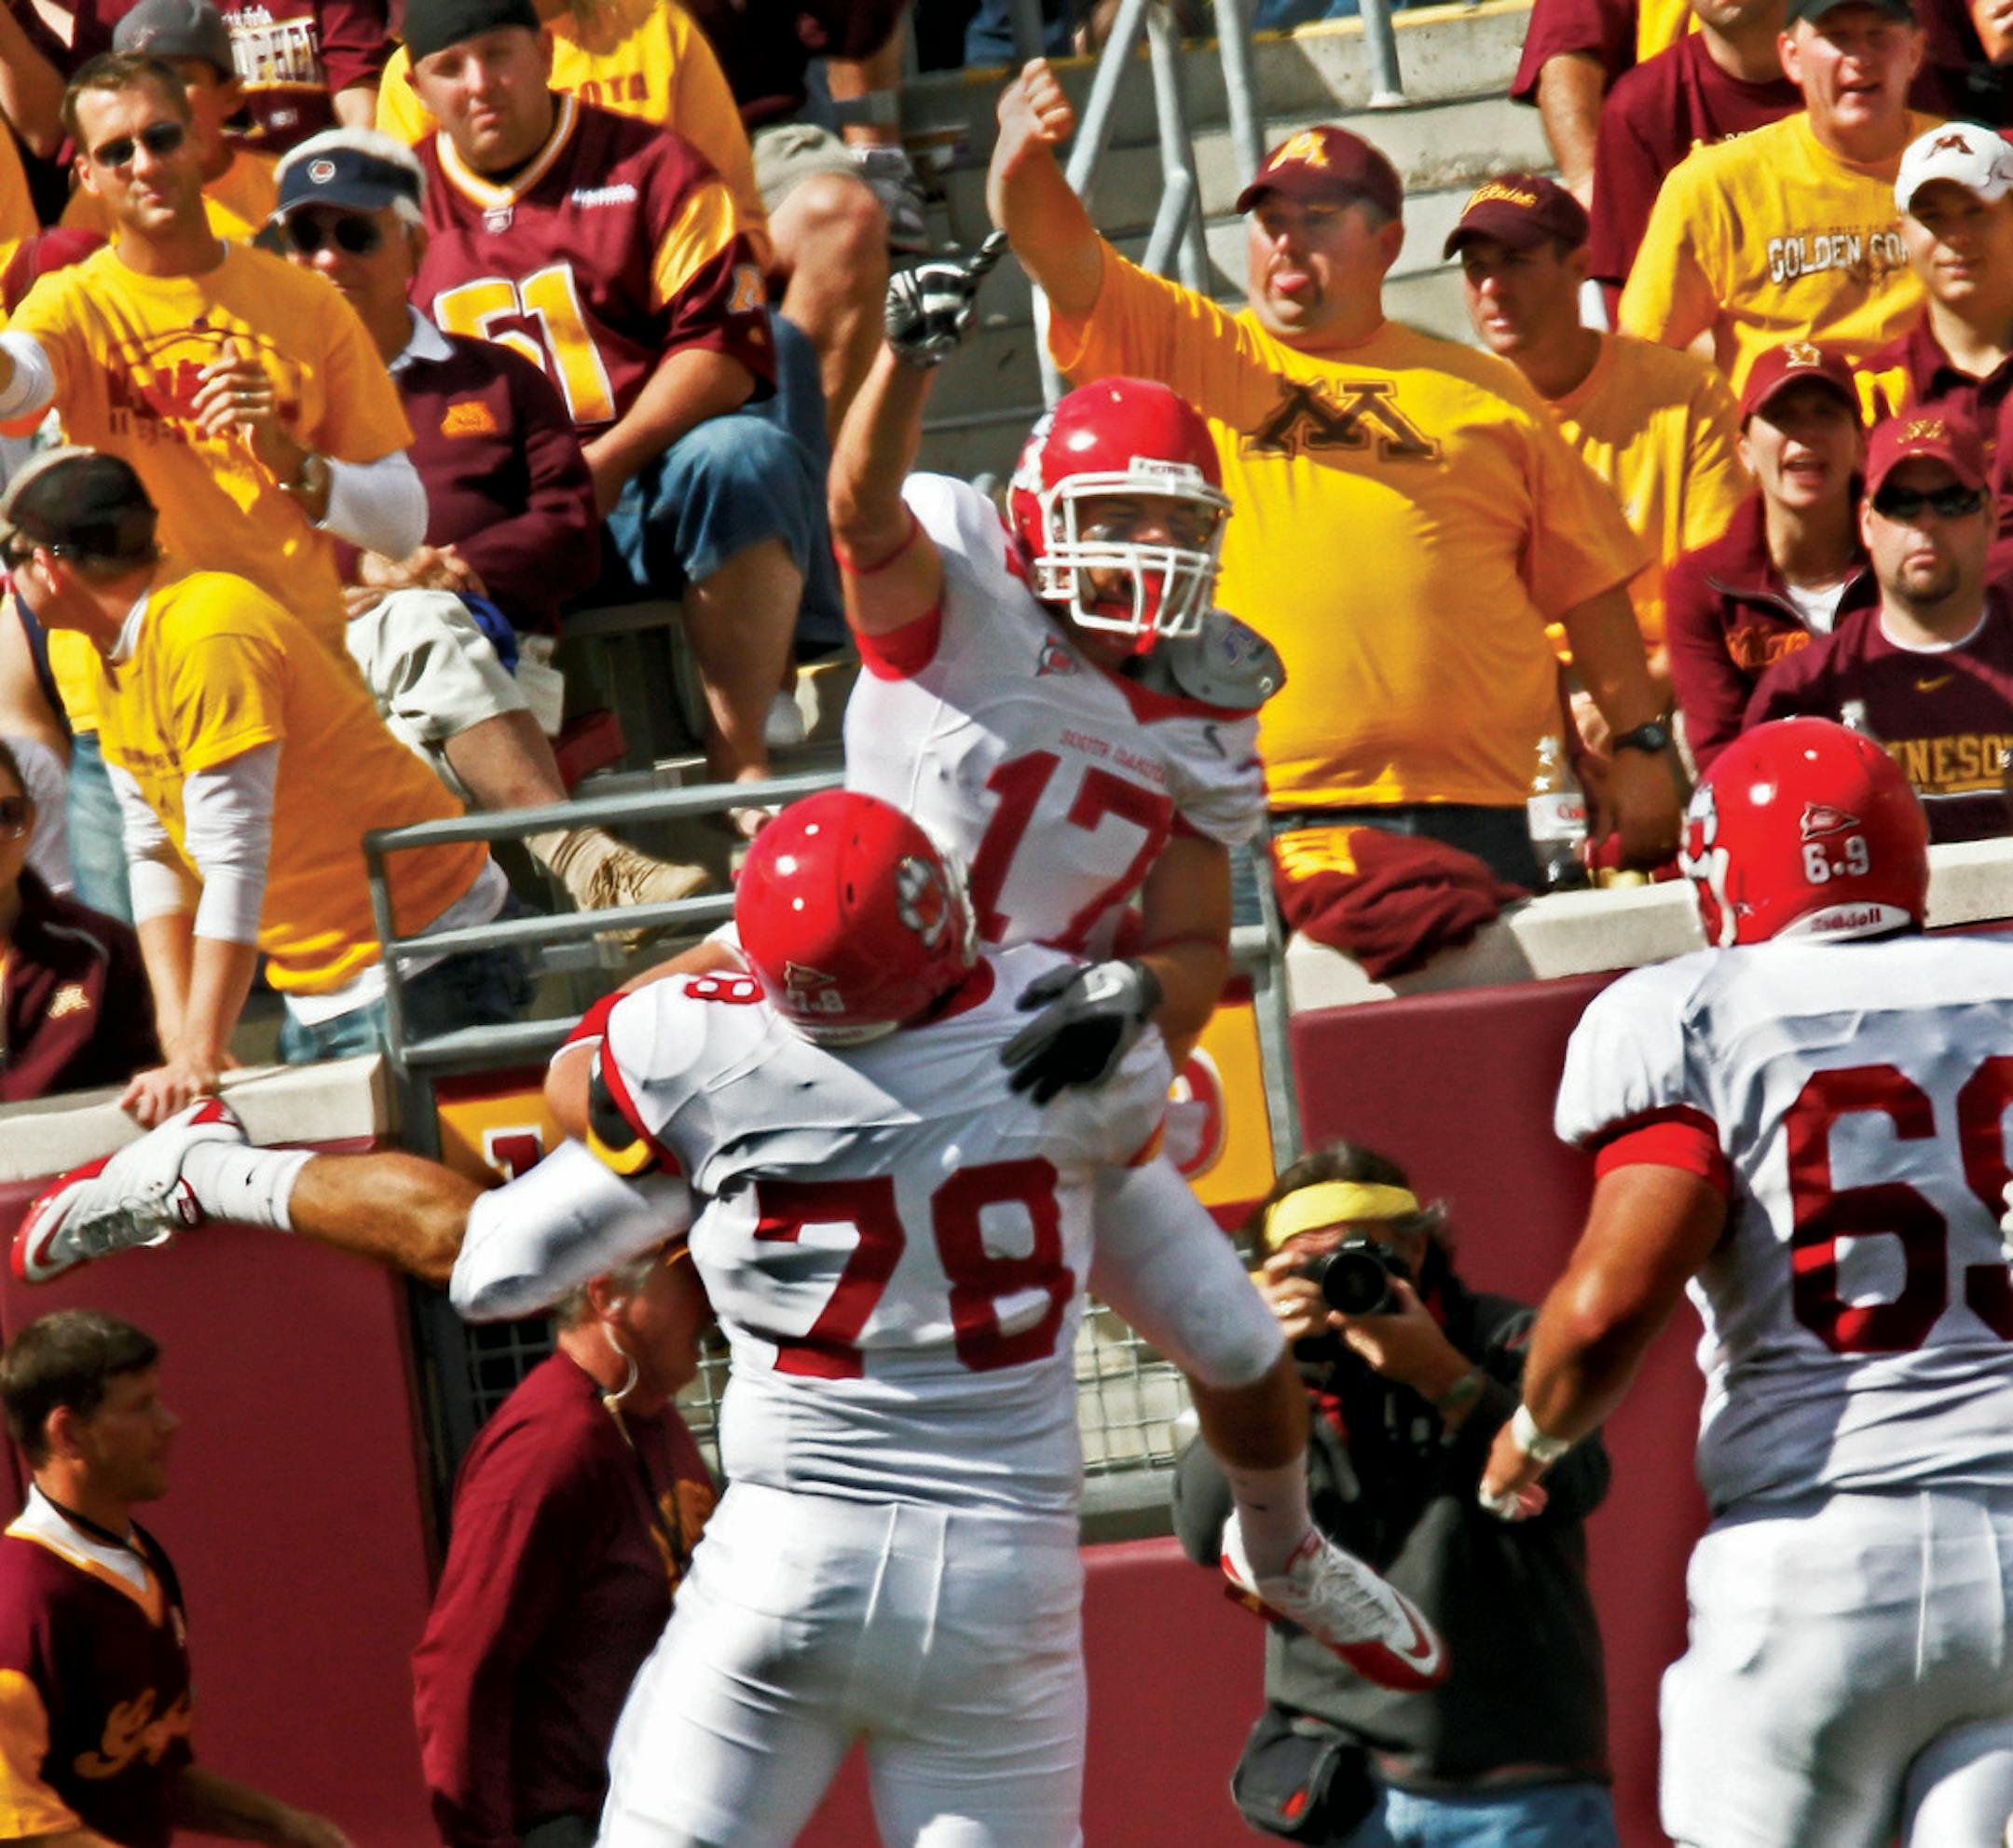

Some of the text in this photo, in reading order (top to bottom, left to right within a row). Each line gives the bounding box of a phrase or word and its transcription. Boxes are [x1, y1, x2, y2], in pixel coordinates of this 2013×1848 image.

[1768, 232, 1862, 284] GOLDEN
[1239, 373, 1444, 462] M
[1886, 732, 2013, 783] NESO
[971, 749, 1173, 954] 17
[1801, 834, 1870, 884] 6.9
[752, 1155, 1076, 1380] 78
